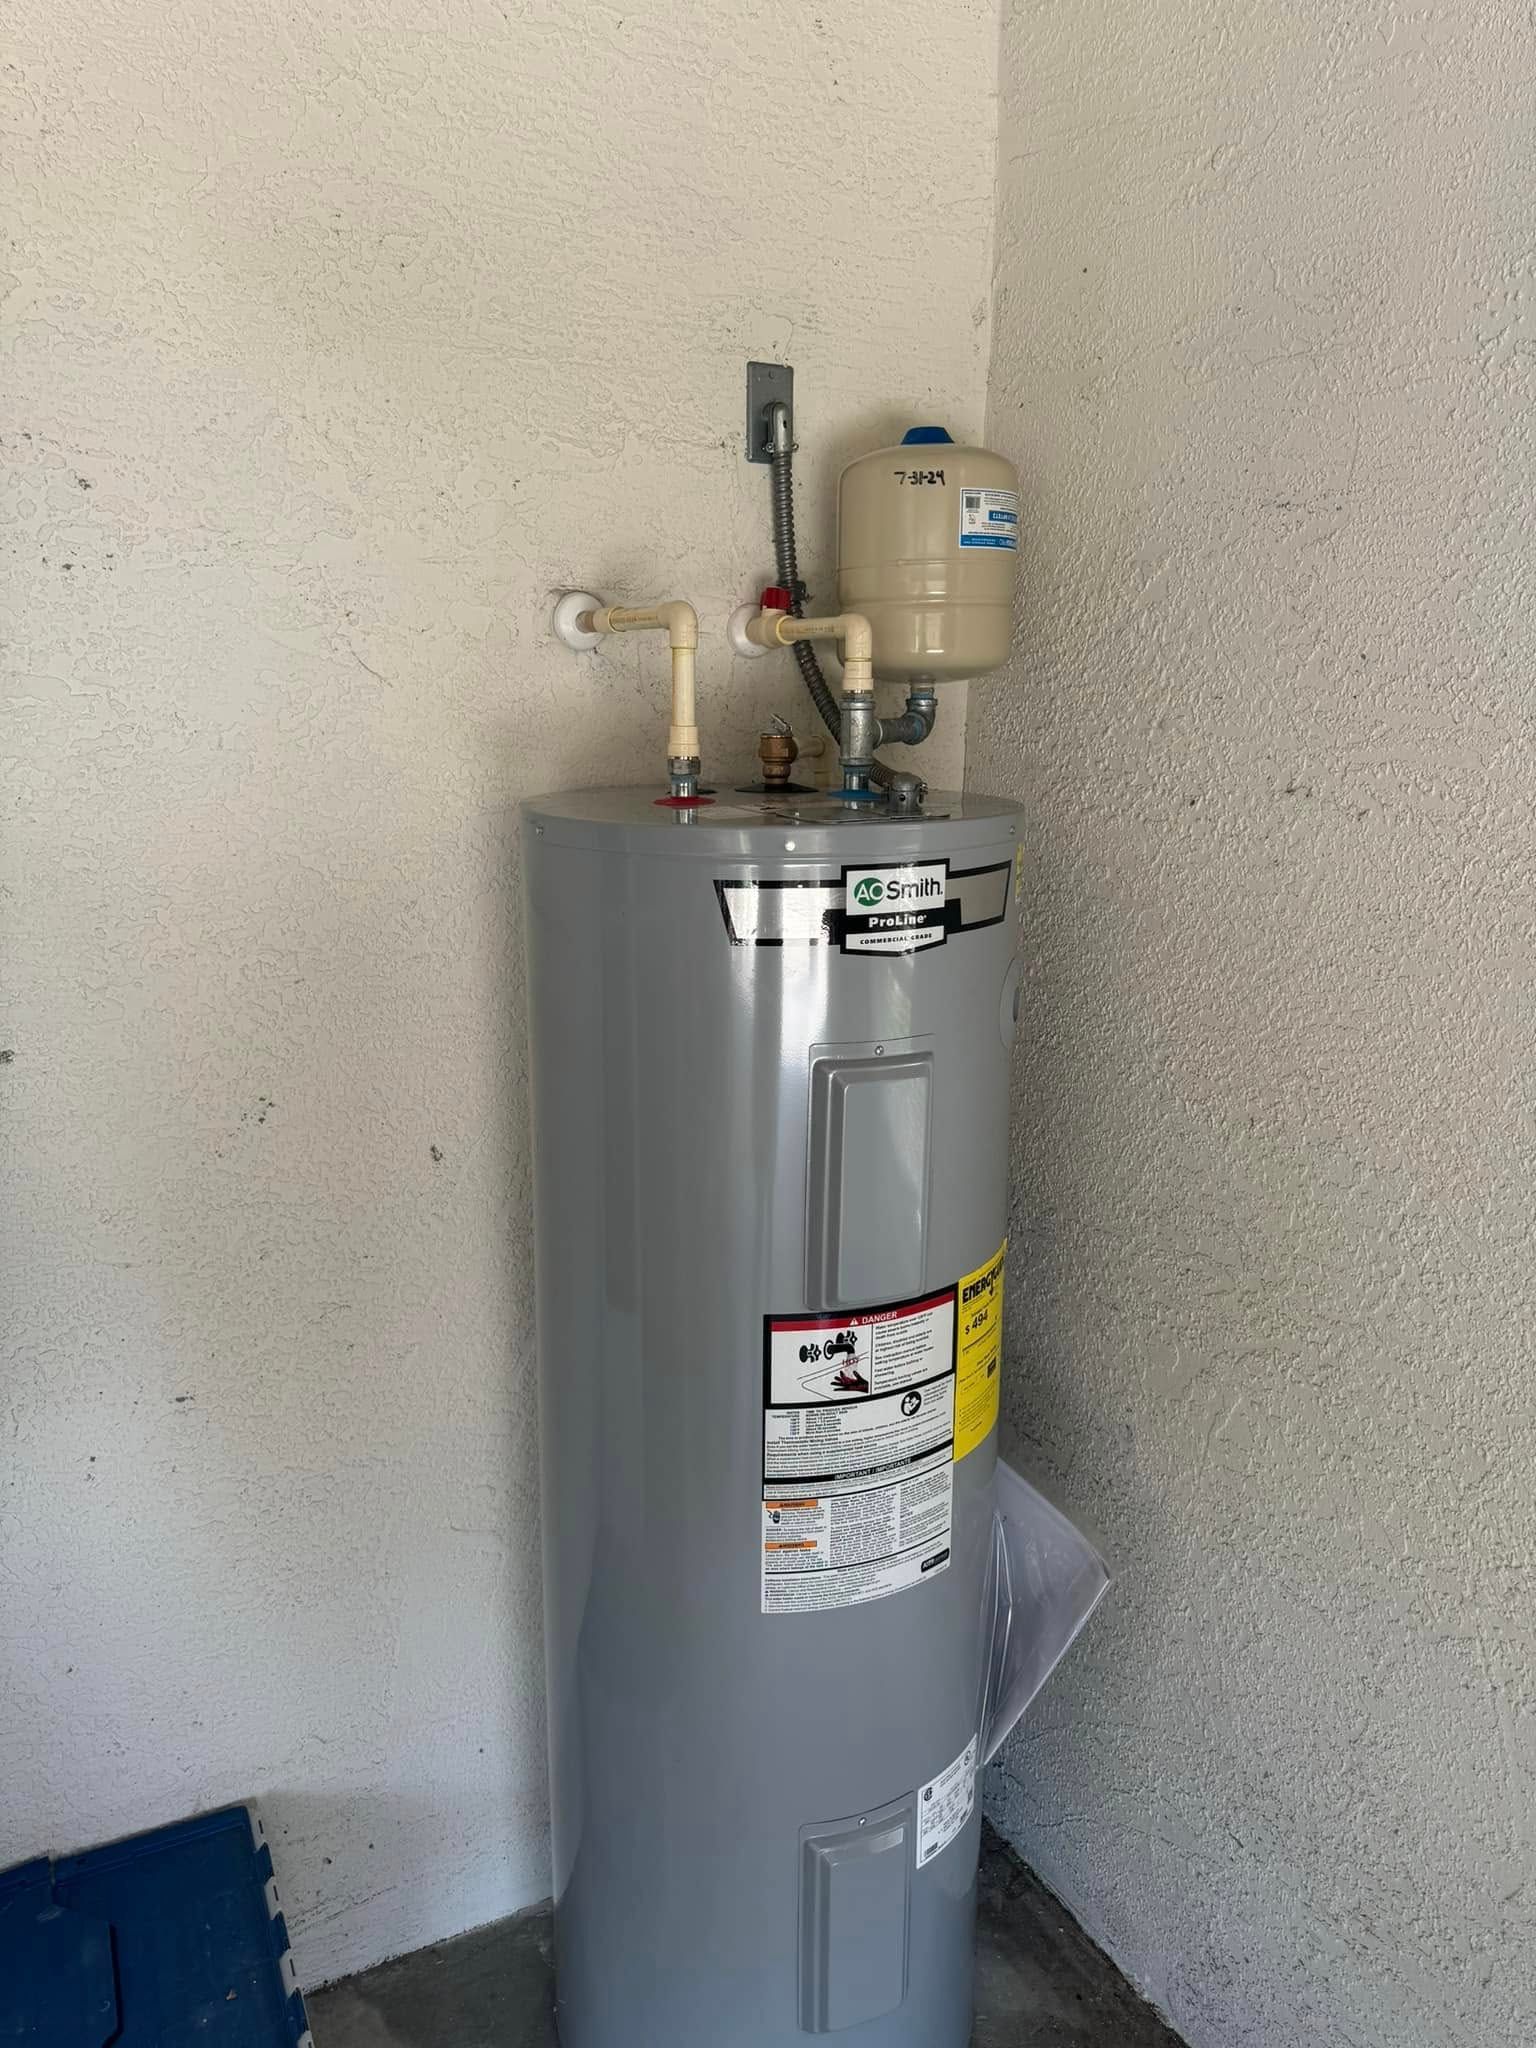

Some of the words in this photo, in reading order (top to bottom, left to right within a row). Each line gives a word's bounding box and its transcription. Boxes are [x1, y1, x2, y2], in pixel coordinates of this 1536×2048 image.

[893, 469, 946, 486] 7-31-24
[868, 914, 925, 928] ProLine
[860, 936, 907, 945] COMMERCIAL
[910, 933, 932, 941] GRADE
[862, 1311, 897, 1324] DANGER
